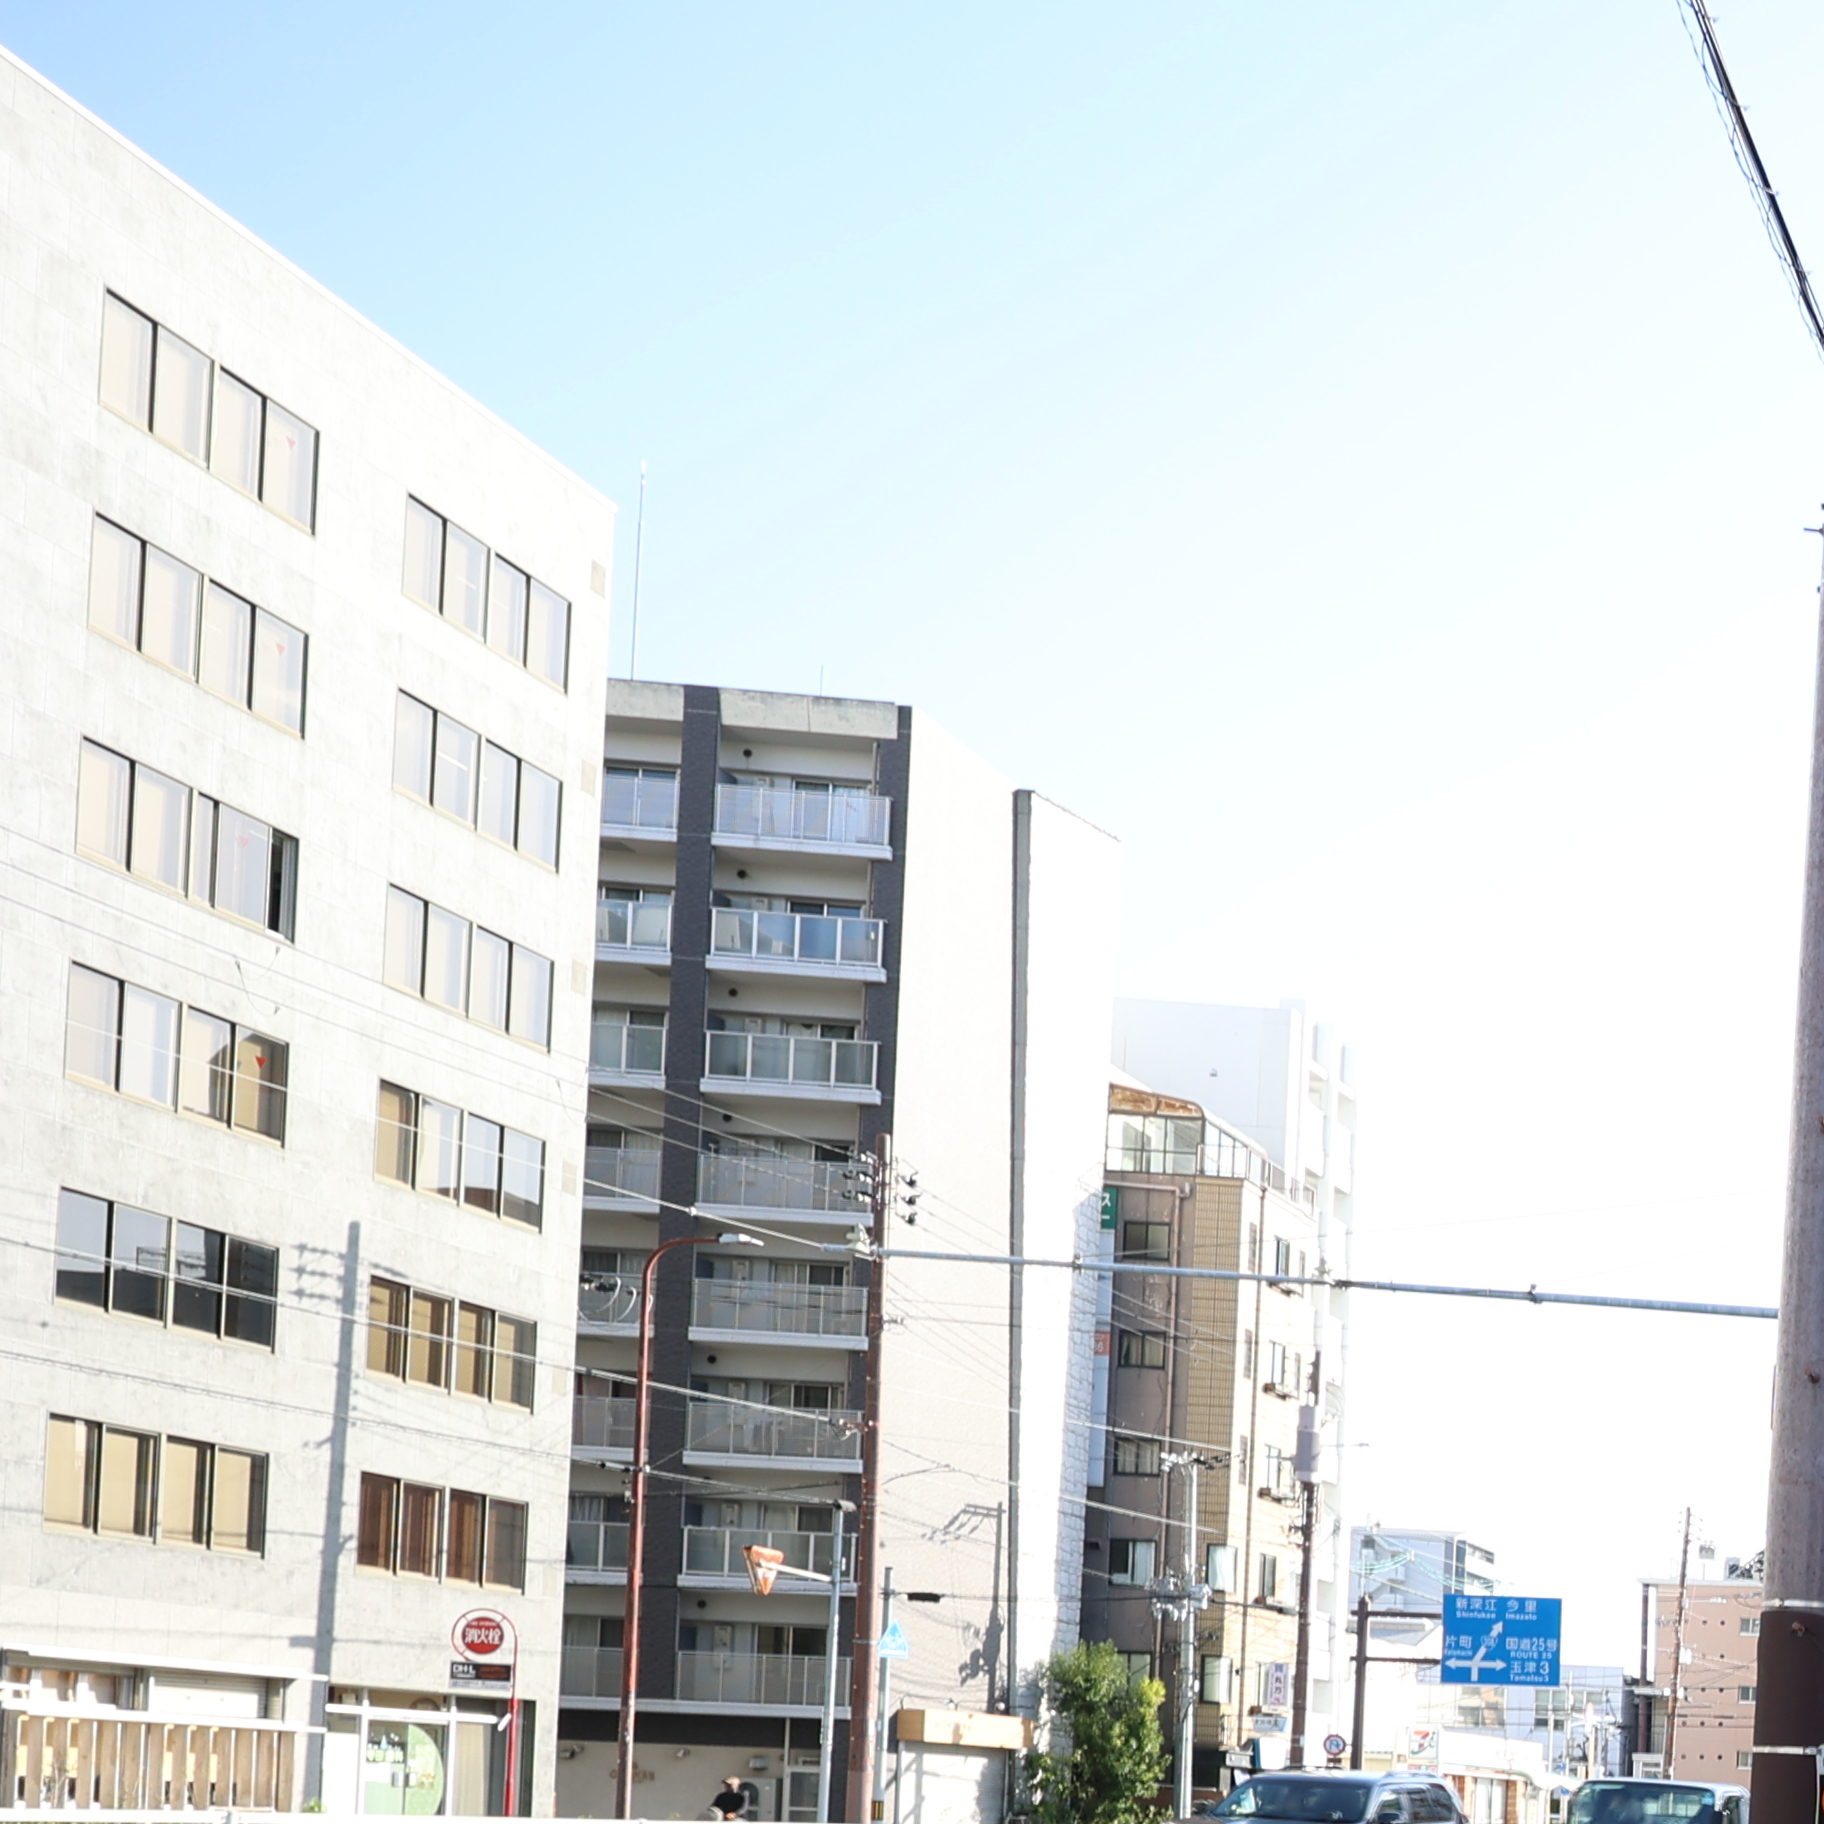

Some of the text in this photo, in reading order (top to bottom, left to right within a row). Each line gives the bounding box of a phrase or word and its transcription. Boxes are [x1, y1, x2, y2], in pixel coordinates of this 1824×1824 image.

[1456, 1597, 1537, 1613] 新深江 今里
[465, 1627, 501, 1644] 消火栓
[1445, 1635, 1472, 1648] 片町
[1506, 1637, 1557, 1651] 国道25号
